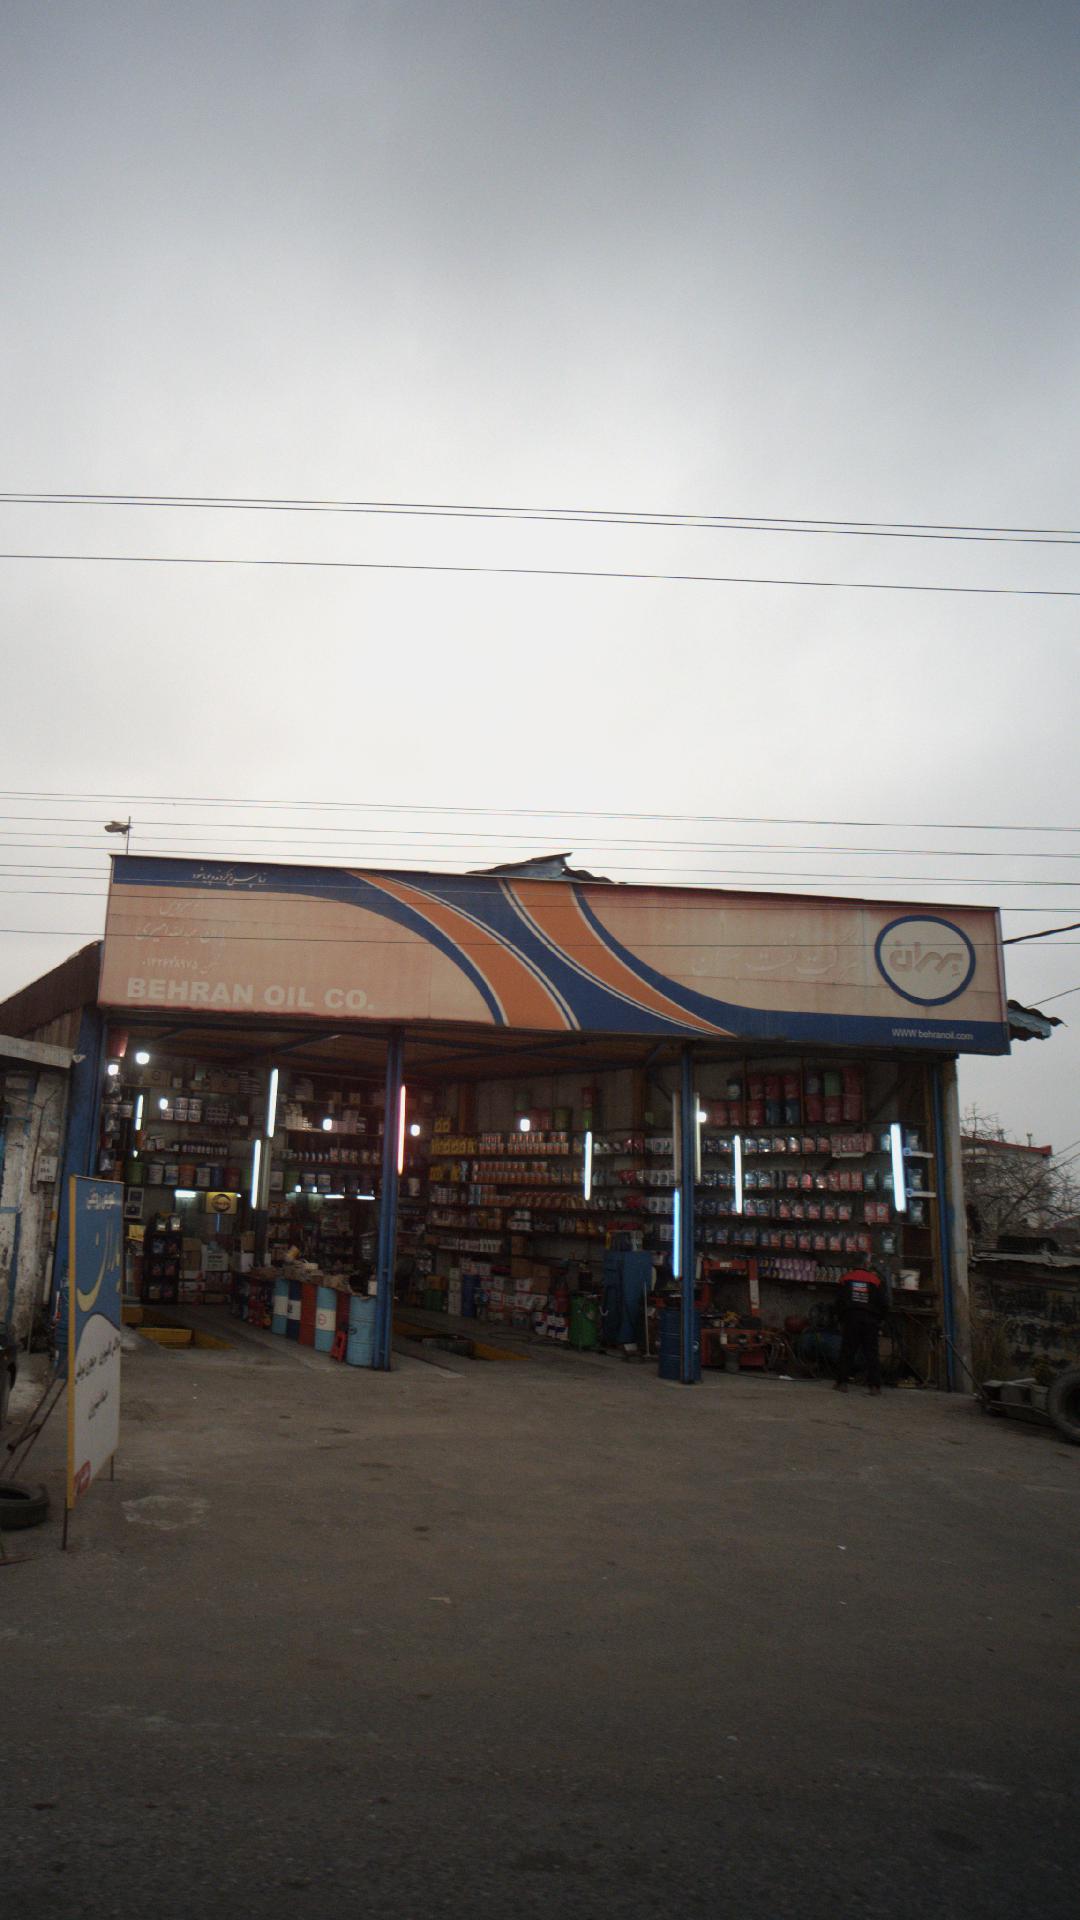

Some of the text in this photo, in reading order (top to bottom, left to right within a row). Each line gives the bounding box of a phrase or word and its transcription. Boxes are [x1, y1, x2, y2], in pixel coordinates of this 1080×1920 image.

[127, 977, 375, 1011] BEHRAN OIL CO.
